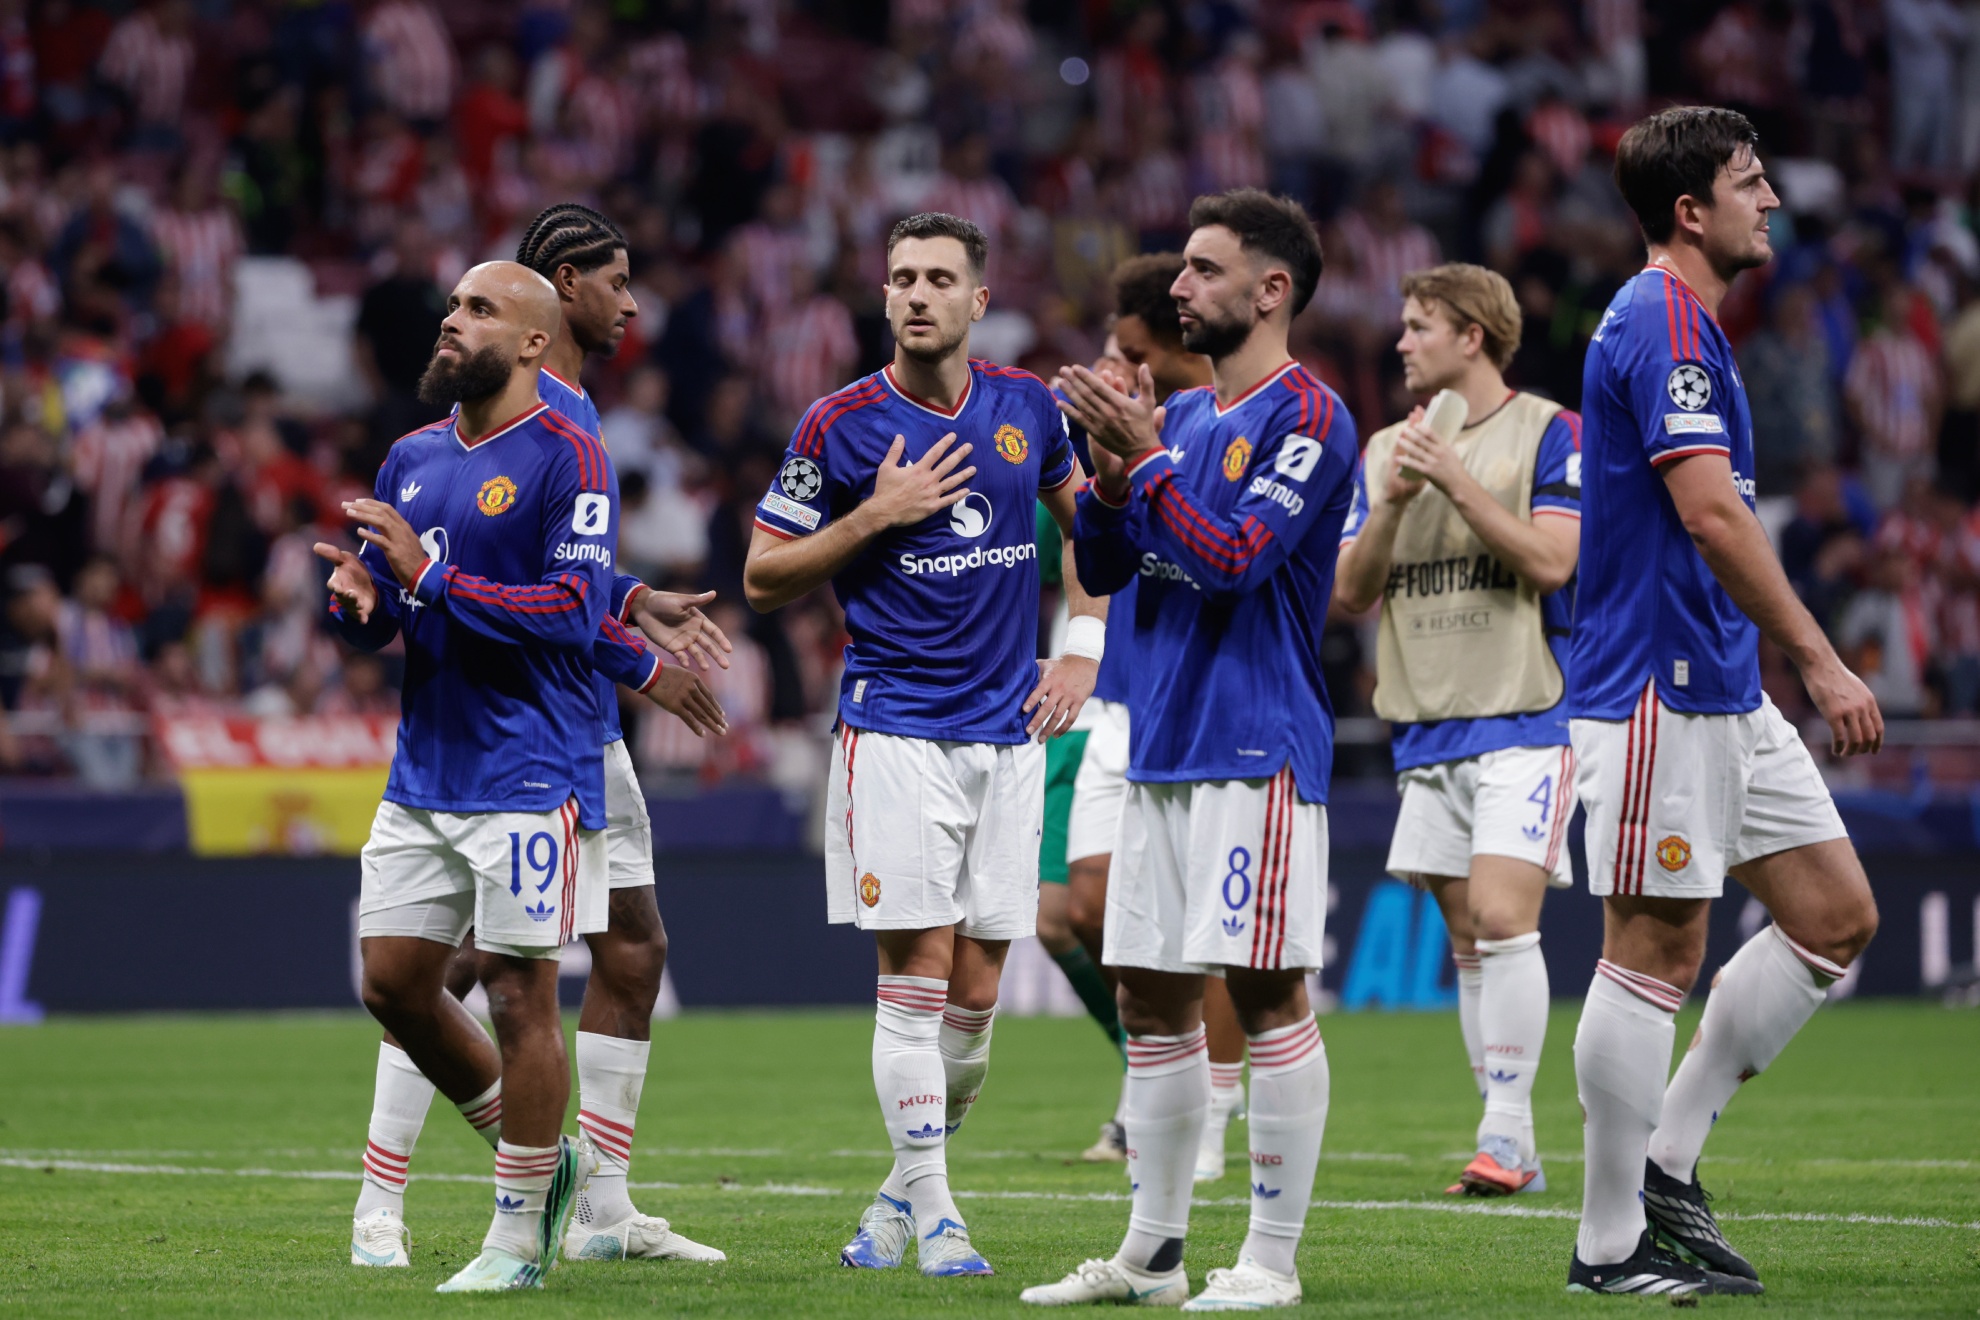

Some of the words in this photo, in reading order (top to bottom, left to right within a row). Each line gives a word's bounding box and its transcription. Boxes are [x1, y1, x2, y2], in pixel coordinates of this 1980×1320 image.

[766, 497, 818, 524] FOUNDATION
[1250, 476, 1304, 517] sumup
[554, 542, 610, 570] sumup
[900, 543, 1036, 576] Snapdragon
[1430, 611, 1491, 630] RESPECT
[1527, 774, 1551, 823] 4
[507, 831, 558, 898] 19
[1222, 846, 1251, 911] 8
[898, 1094, 943, 1110] MUFC
